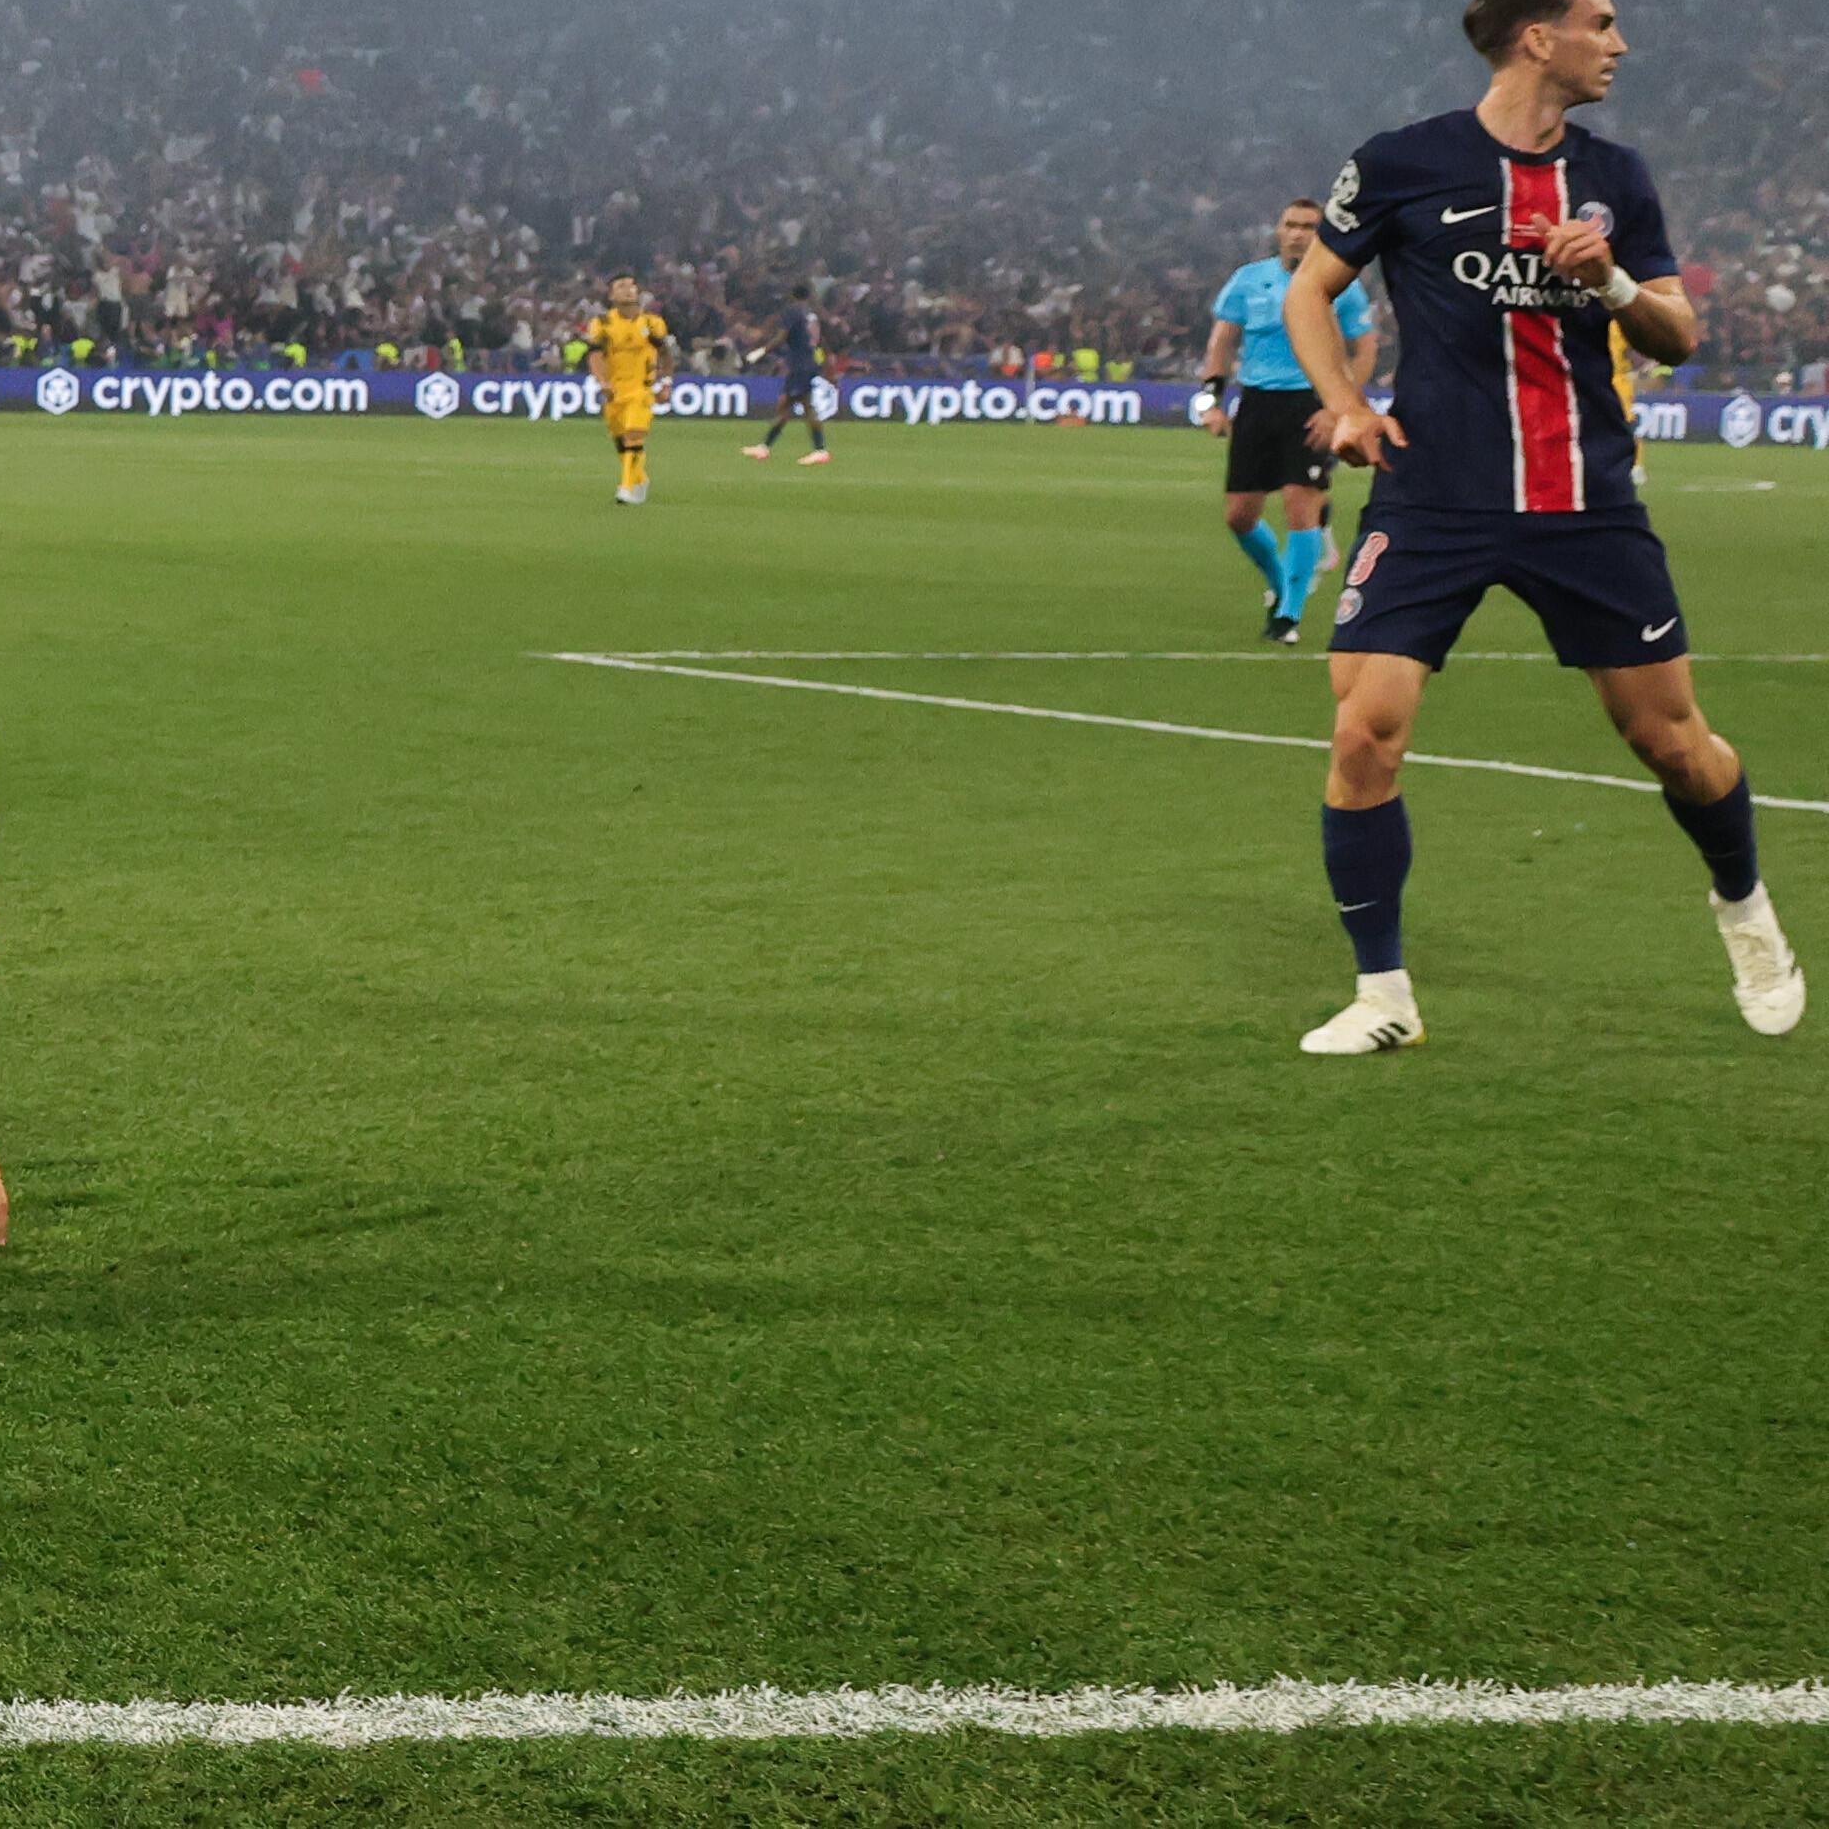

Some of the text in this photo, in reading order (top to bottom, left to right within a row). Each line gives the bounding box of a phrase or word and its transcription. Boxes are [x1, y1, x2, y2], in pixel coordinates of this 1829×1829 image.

[1452, 251, 1581, 291] QAT
[92, 370, 368, 417] crypto.com
[850, 377, 1141, 425] crypto.com
